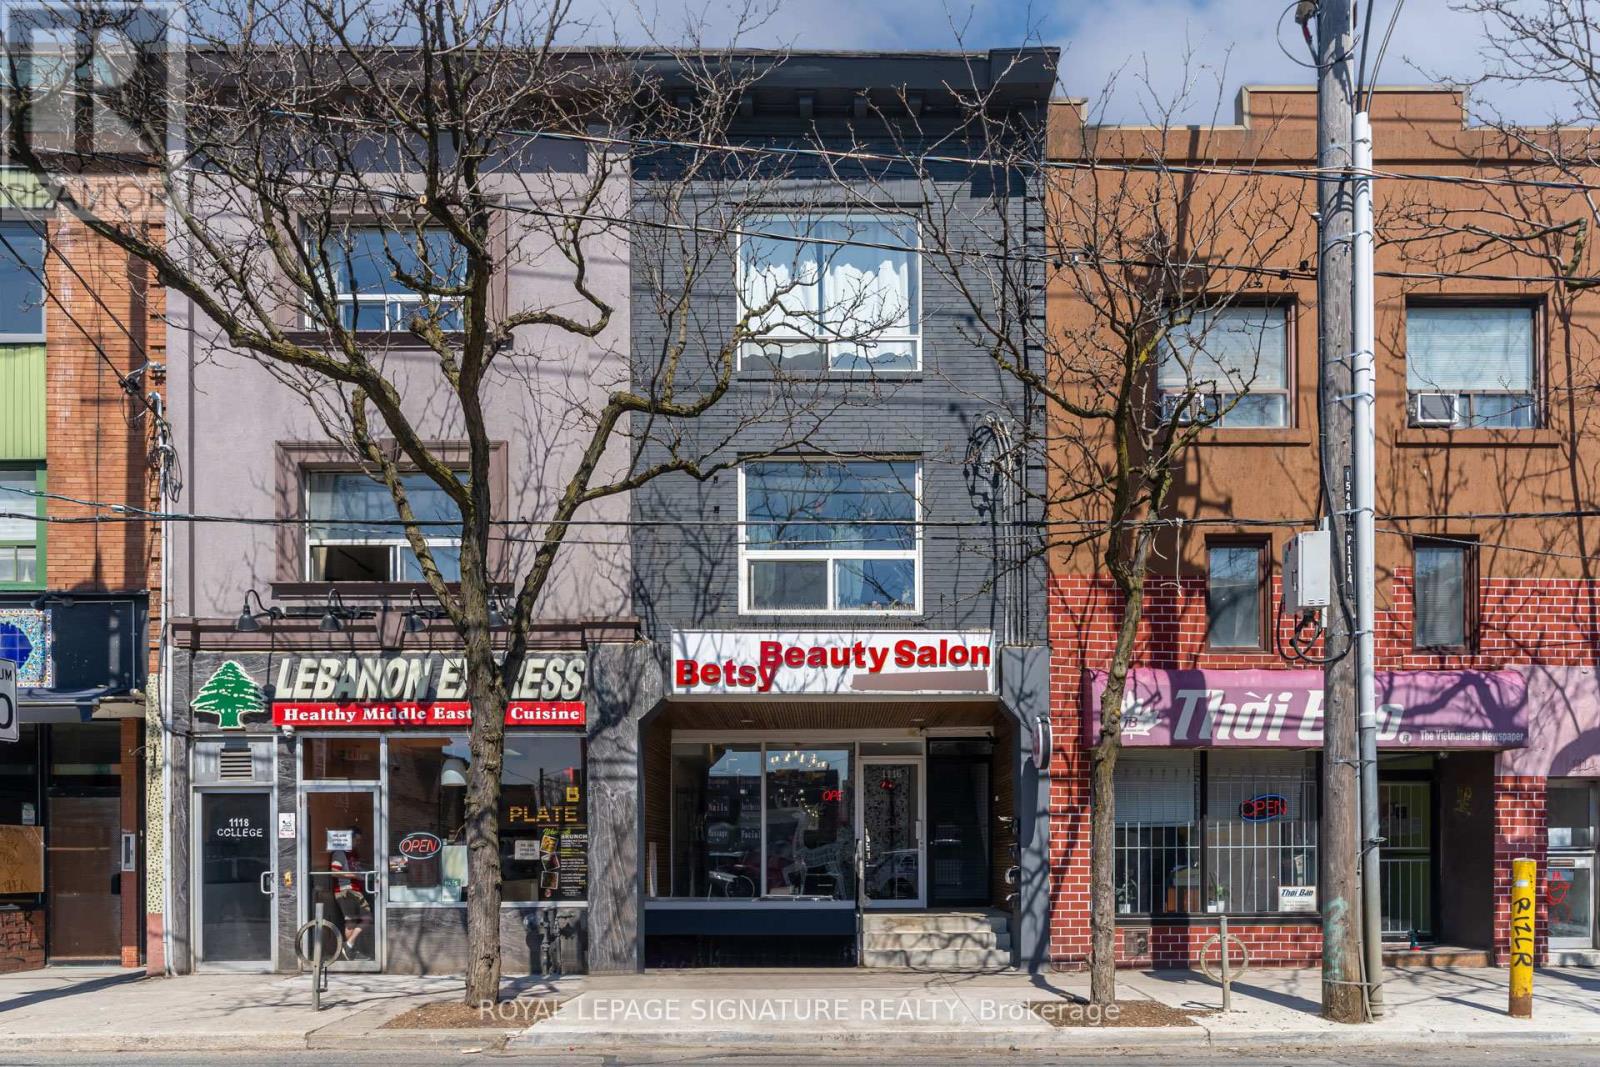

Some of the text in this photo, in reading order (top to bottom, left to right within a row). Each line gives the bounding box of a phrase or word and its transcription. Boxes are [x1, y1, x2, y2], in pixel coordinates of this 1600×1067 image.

[760, 639, 990, 674] Beauty Salon
[274, 657, 433, 699] LEBANON
[676, 659, 778, 692] Betsy
[283, 707, 357, 722] Healthy
[362, 707, 427, 721] Middle
[510, 706, 580, 720] Cuisine
[1420, 730, 1524, 743] The Vietnamese Newspaper
[509, 804, 578, 822] PLATE
[1242, 799, 1287, 817] OPEN
[228, 818, 249, 828] 1118
[216, 828, 263, 838] COLLEGE
[401, 839, 437, 853] OPEN
